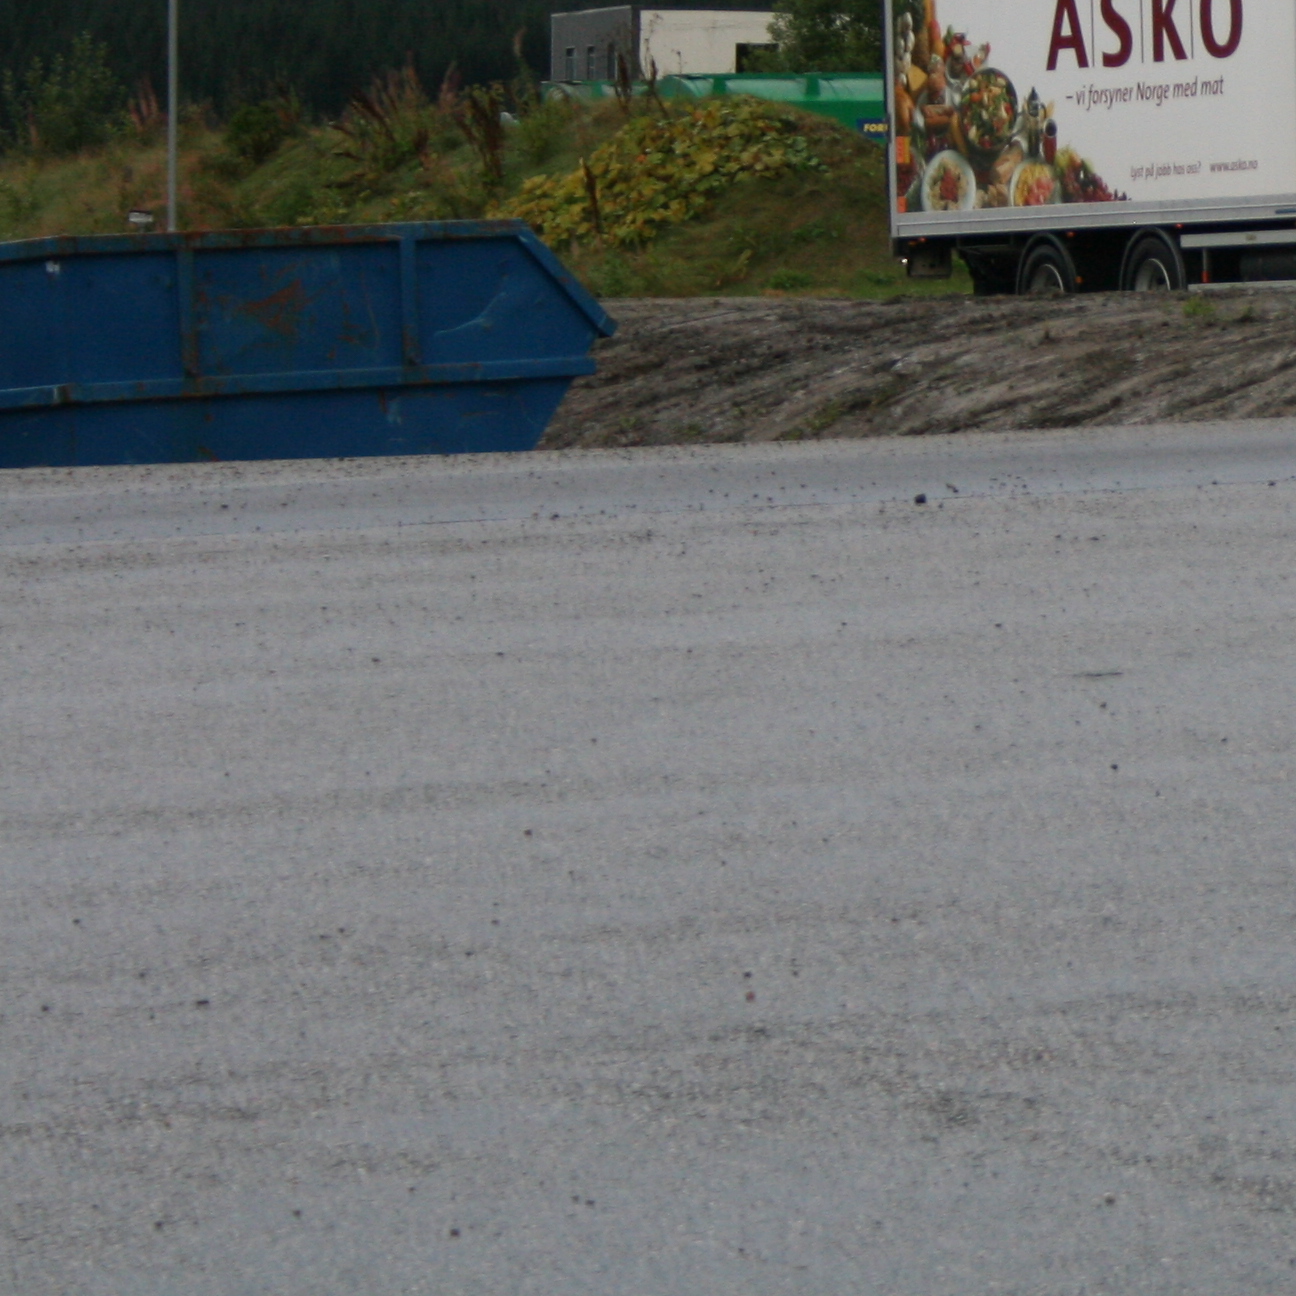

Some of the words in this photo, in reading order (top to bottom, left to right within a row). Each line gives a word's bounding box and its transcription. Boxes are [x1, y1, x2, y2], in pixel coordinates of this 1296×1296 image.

[1075, 85, 1086, 105] vi
[1086, 84, 1133, 111] forsyner
[1136, 81, 1170, 107] Norge
[1172, 75, 1198, 98] med
[1200, 75, 1224, 95] mat
